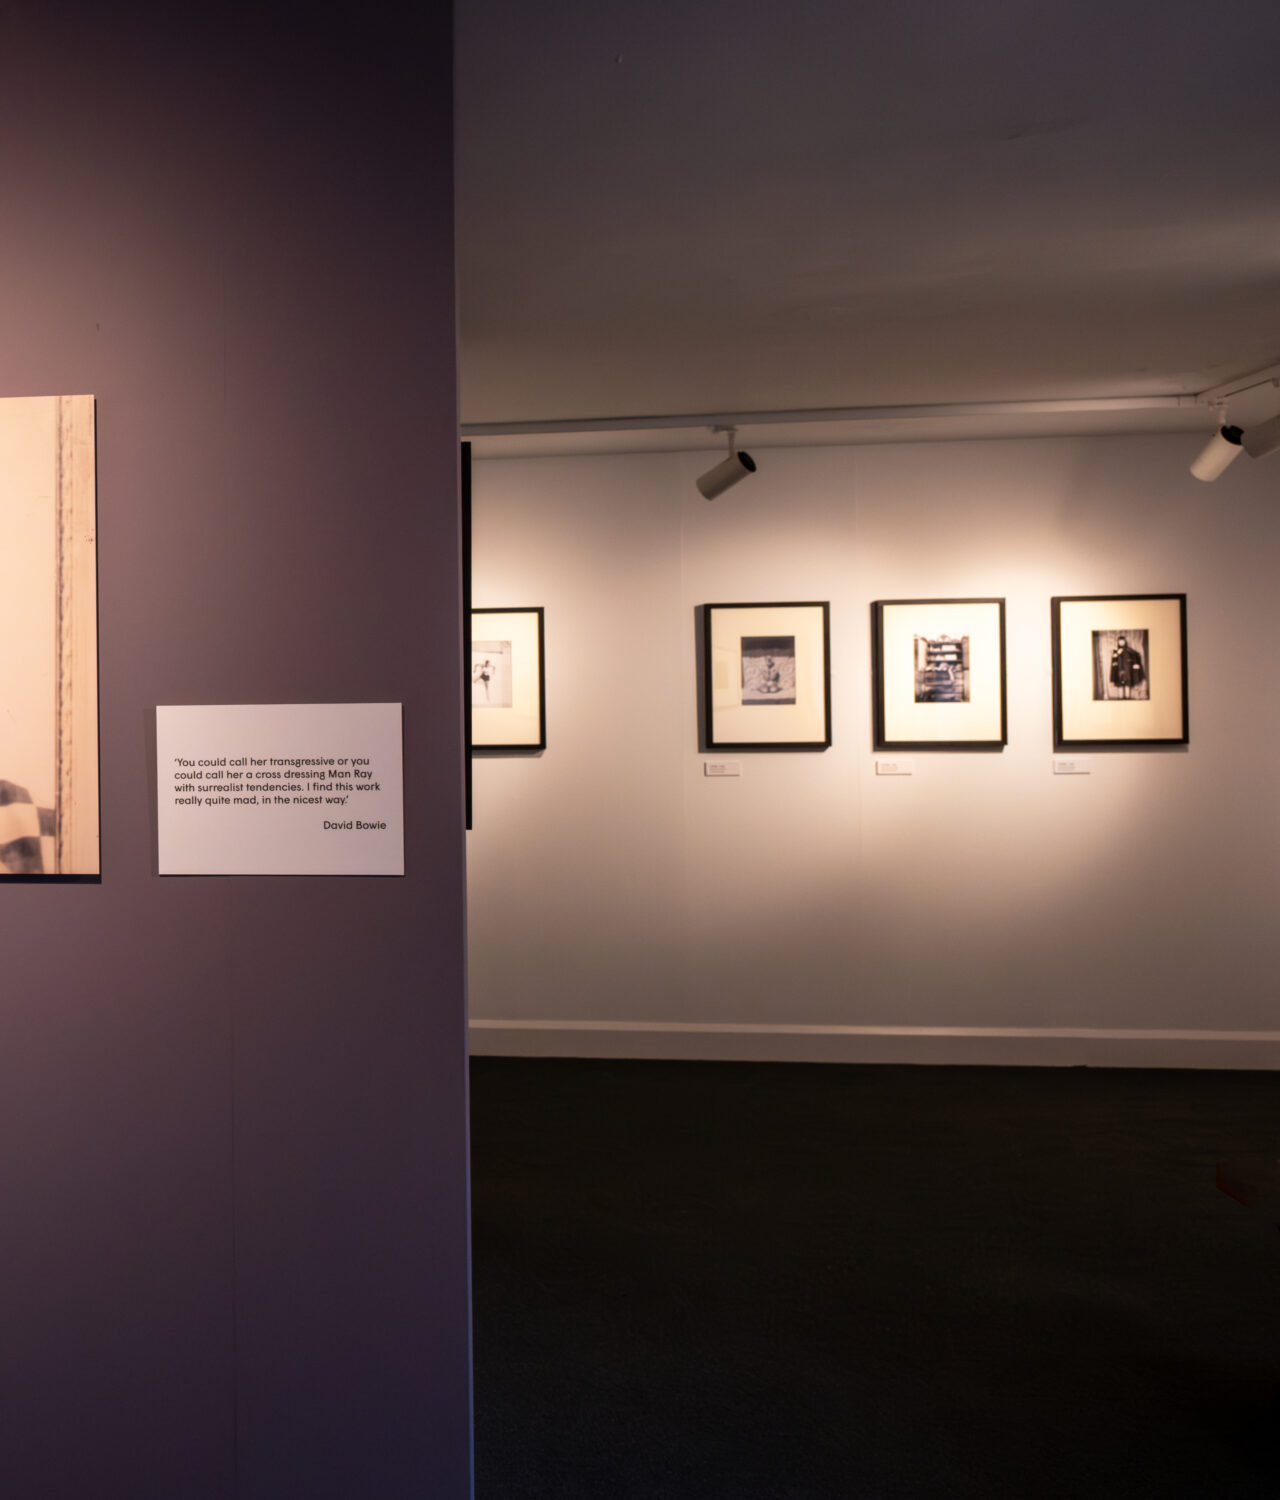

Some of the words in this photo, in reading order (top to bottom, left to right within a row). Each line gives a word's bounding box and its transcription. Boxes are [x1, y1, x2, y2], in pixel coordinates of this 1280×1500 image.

[198, 758, 226, 766] could
[229, 758, 247, 766] call
[250, 757, 267, 766] her
[270, 757, 335, 768] transgressive
[351, 758, 369, 767] you
[174, 771, 202, 780] could
[206, 770, 223, 779] call
[227, 770, 244, 779] her
[284, 770, 325, 780] dressing
[328, 770, 351, 778] Man
[354, 770, 372, 780] Ray
[174, 784, 195, 792] with
[198, 783, 244, 792] surrealist
[246, 783, 304, 791] tendencies.
[307, 782, 310, 791] I
[312, 782, 332, 791] find
[335, 782, 353, 791] this
[356, 782, 380, 791] work
[175, 796, 202, 806] really
[205, 796, 230, 806] quite
[234, 796, 259, 805] mad,
[262, 796, 271, 804] in
[274, 796, 290, 804] the
[293, 795, 323, 804] nicest
[324, 821, 352, 829] David
[356, 821, 386, 830] Bowie
